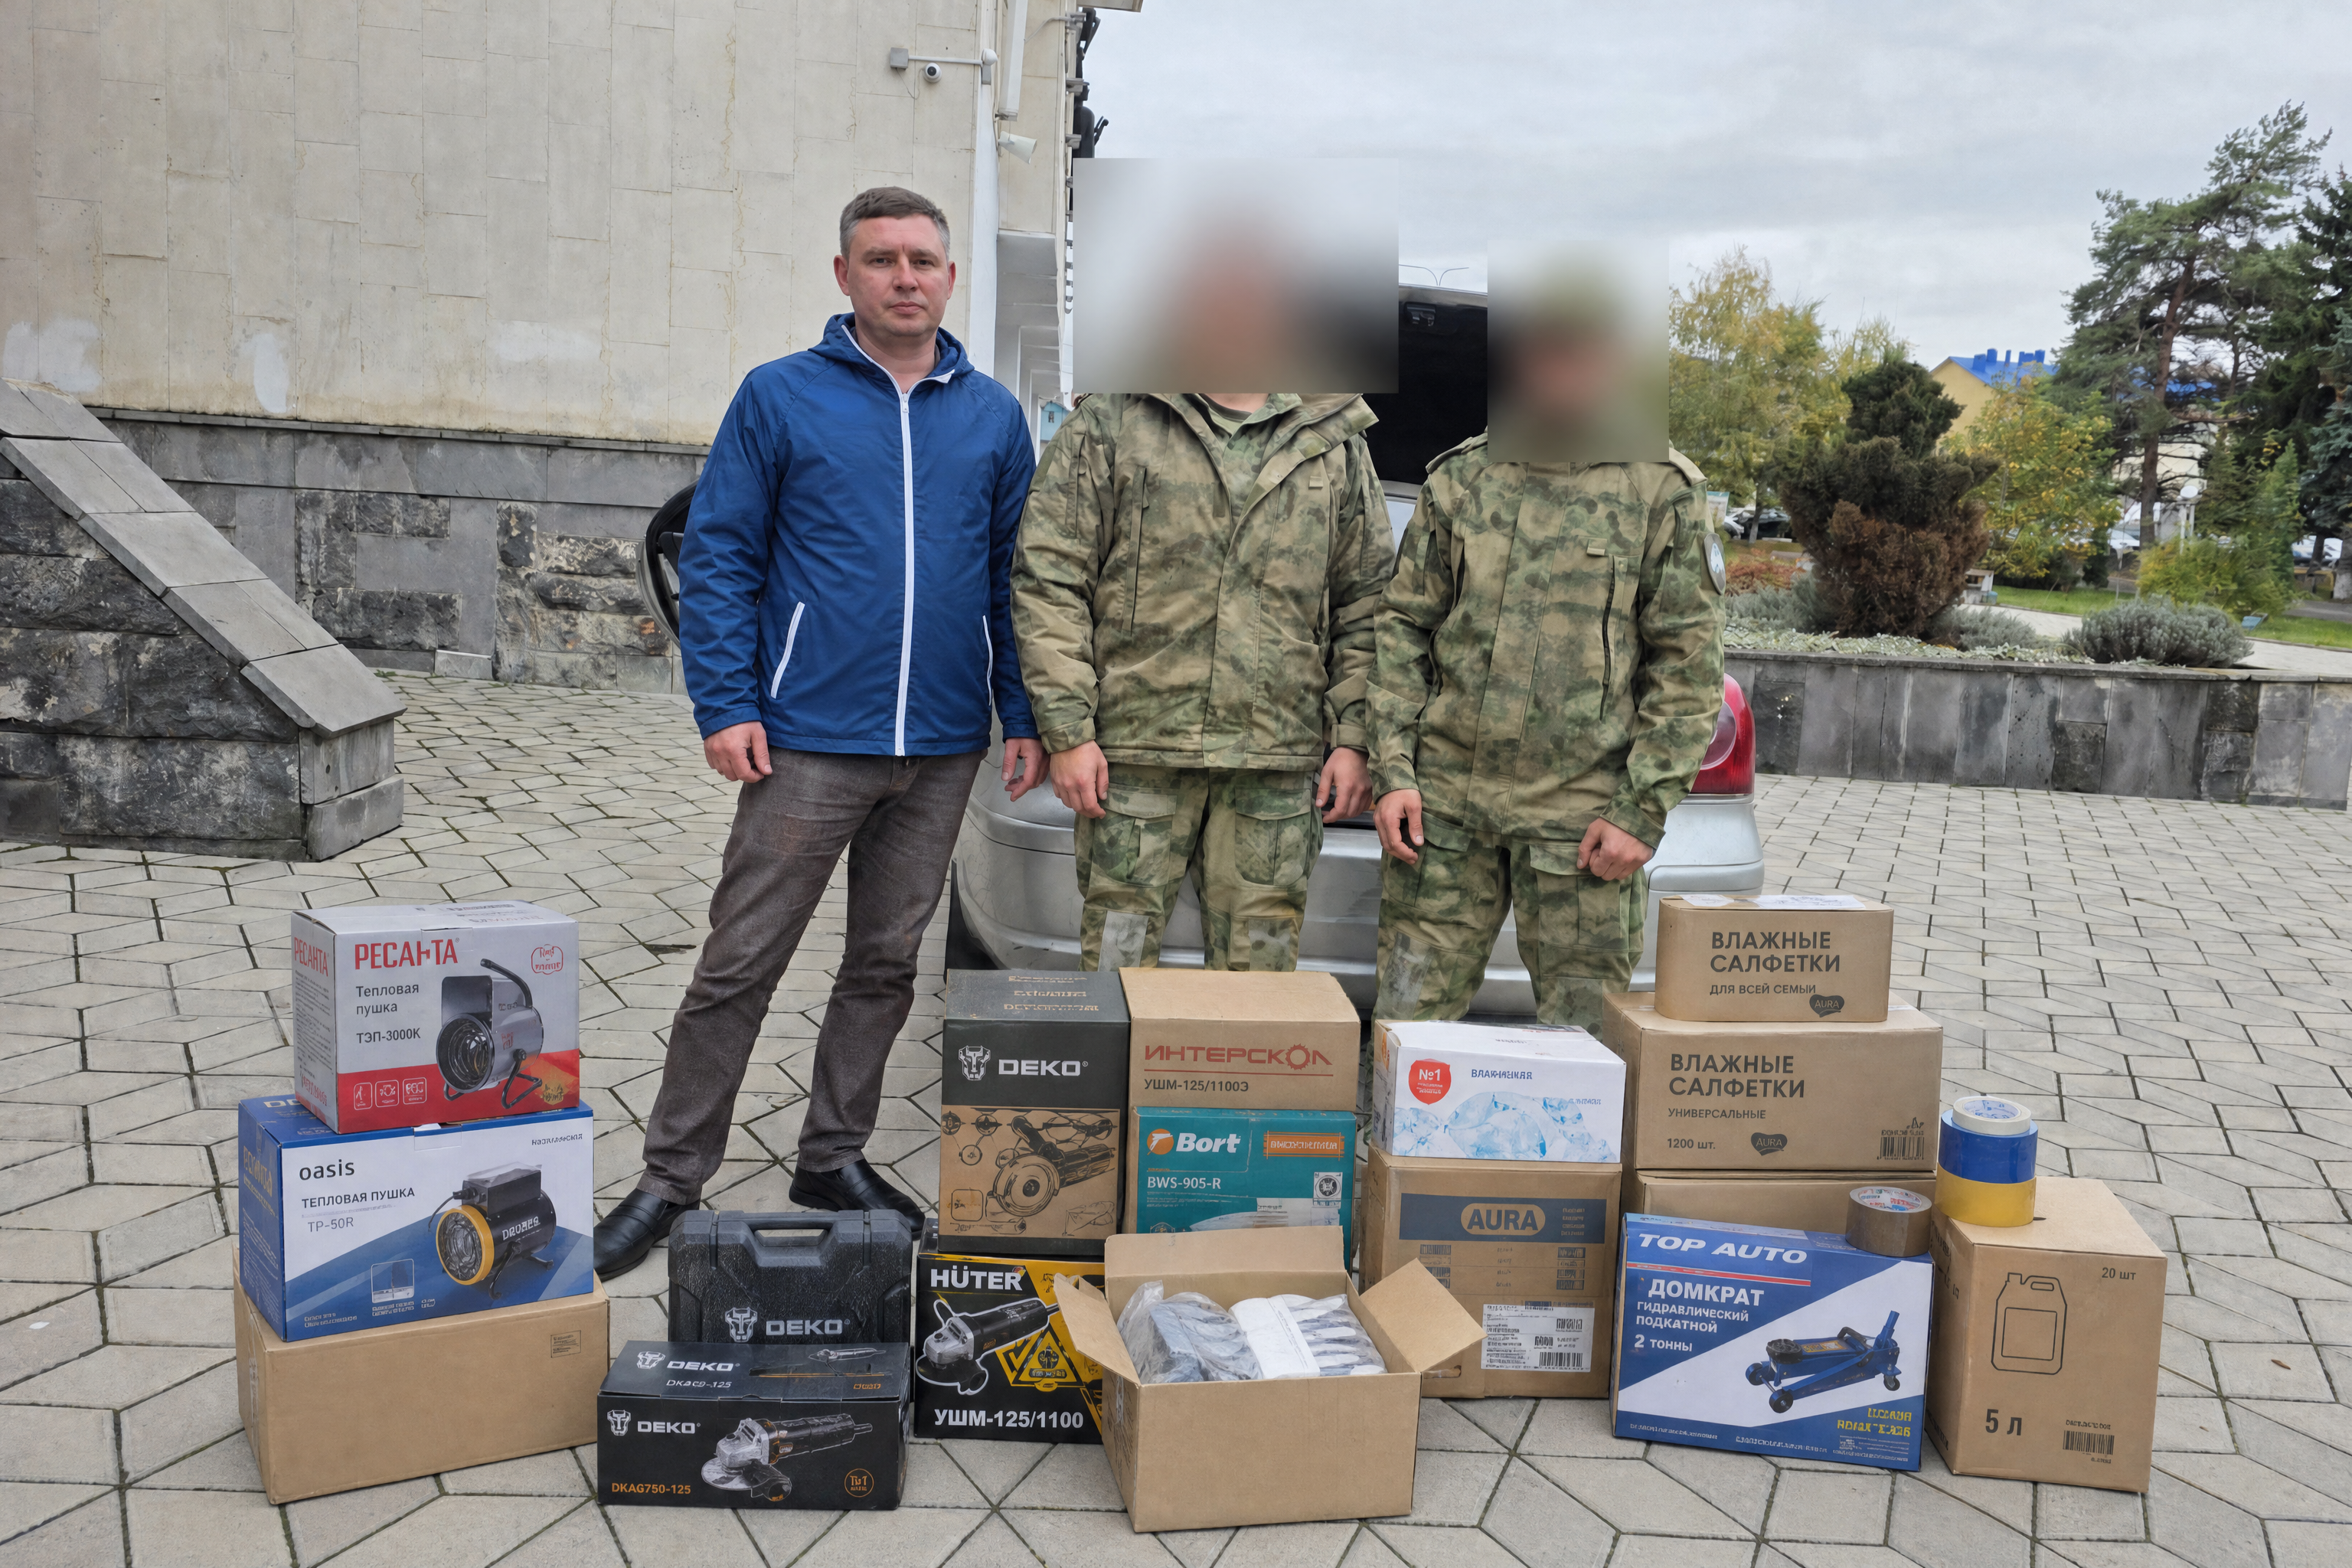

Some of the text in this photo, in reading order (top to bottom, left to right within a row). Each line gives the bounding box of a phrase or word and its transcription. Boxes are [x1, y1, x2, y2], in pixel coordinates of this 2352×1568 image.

[1711, 931, 1831, 949] ВЛАЖНЫЕ
[294, 936, 328, 977] РЕСАНТА
[354, 939, 458, 970] РЕСАНТА
[1710, 954, 1841, 973] САЛФЕТКИ
[356, 984, 420, 998] Тепловая
[1710, 982, 1816, 996] ДЛЯ ВСЕЙ СЕМЬИ
[356, 1001, 398, 1018] пушка
[1814, 999, 1840, 1008] AURA
[1145, 1044, 1333, 1070] ИНТЕРСКОЛ
[1671, 1053, 1794, 1073] ВЛАЖНЫЕ
[998, 1059, 1081, 1076] DEKO
[1419, 1069, 1441, 1081] №1
[1144, 1079, 1249, 1093] УШМ-125/1100Э
[1669, 1076, 1805, 1099] САЛФЕТКИ
[1668, 1108, 1766, 1119] УНИВЕРСАЛЬНЫЕ
[1176, 1132, 1241, 1154] Bort
[1667, 1138, 1694, 1148] 1200
[1756, 1138, 1782, 1147] AURA
[299, 1158, 355, 1181] oasis
[1147, 1177, 1221, 1190] BWS-905-R
[302, 1187, 416, 1208] ТЕПЛОВАЯ ПУШКА
[308, 1217, 354, 1233] TP-50R
[1467, 1209, 1539, 1231] AURA
[1638, 1233, 1808, 1264] TOP AUTO
[930, 1266, 1022, 1291] HÜTER
[2102, 1267, 2137, 1281] 20 шт
[1648, 1279, 1765, 1306] ДОМКРАТ
[1637, 1302, 1749, 1322] ГИДРАВЛИЧЕСКИЙ
[766, 1319, 843, 1336] DEKO
[1636, 1315, 1717, 1333] ПОДКАТНОЙ
[1635, 1334, 1645, 1348] 2
[667, 1361, 734, 1371] DEKO
[637, 1420, 695, 1434] DEKO
[934, 1409, 1083, 1429] УШМ-125/1100
[1985, 1409, 1999, 1435] 5
[612, 1482, 691, 1494] DKAG750-125
